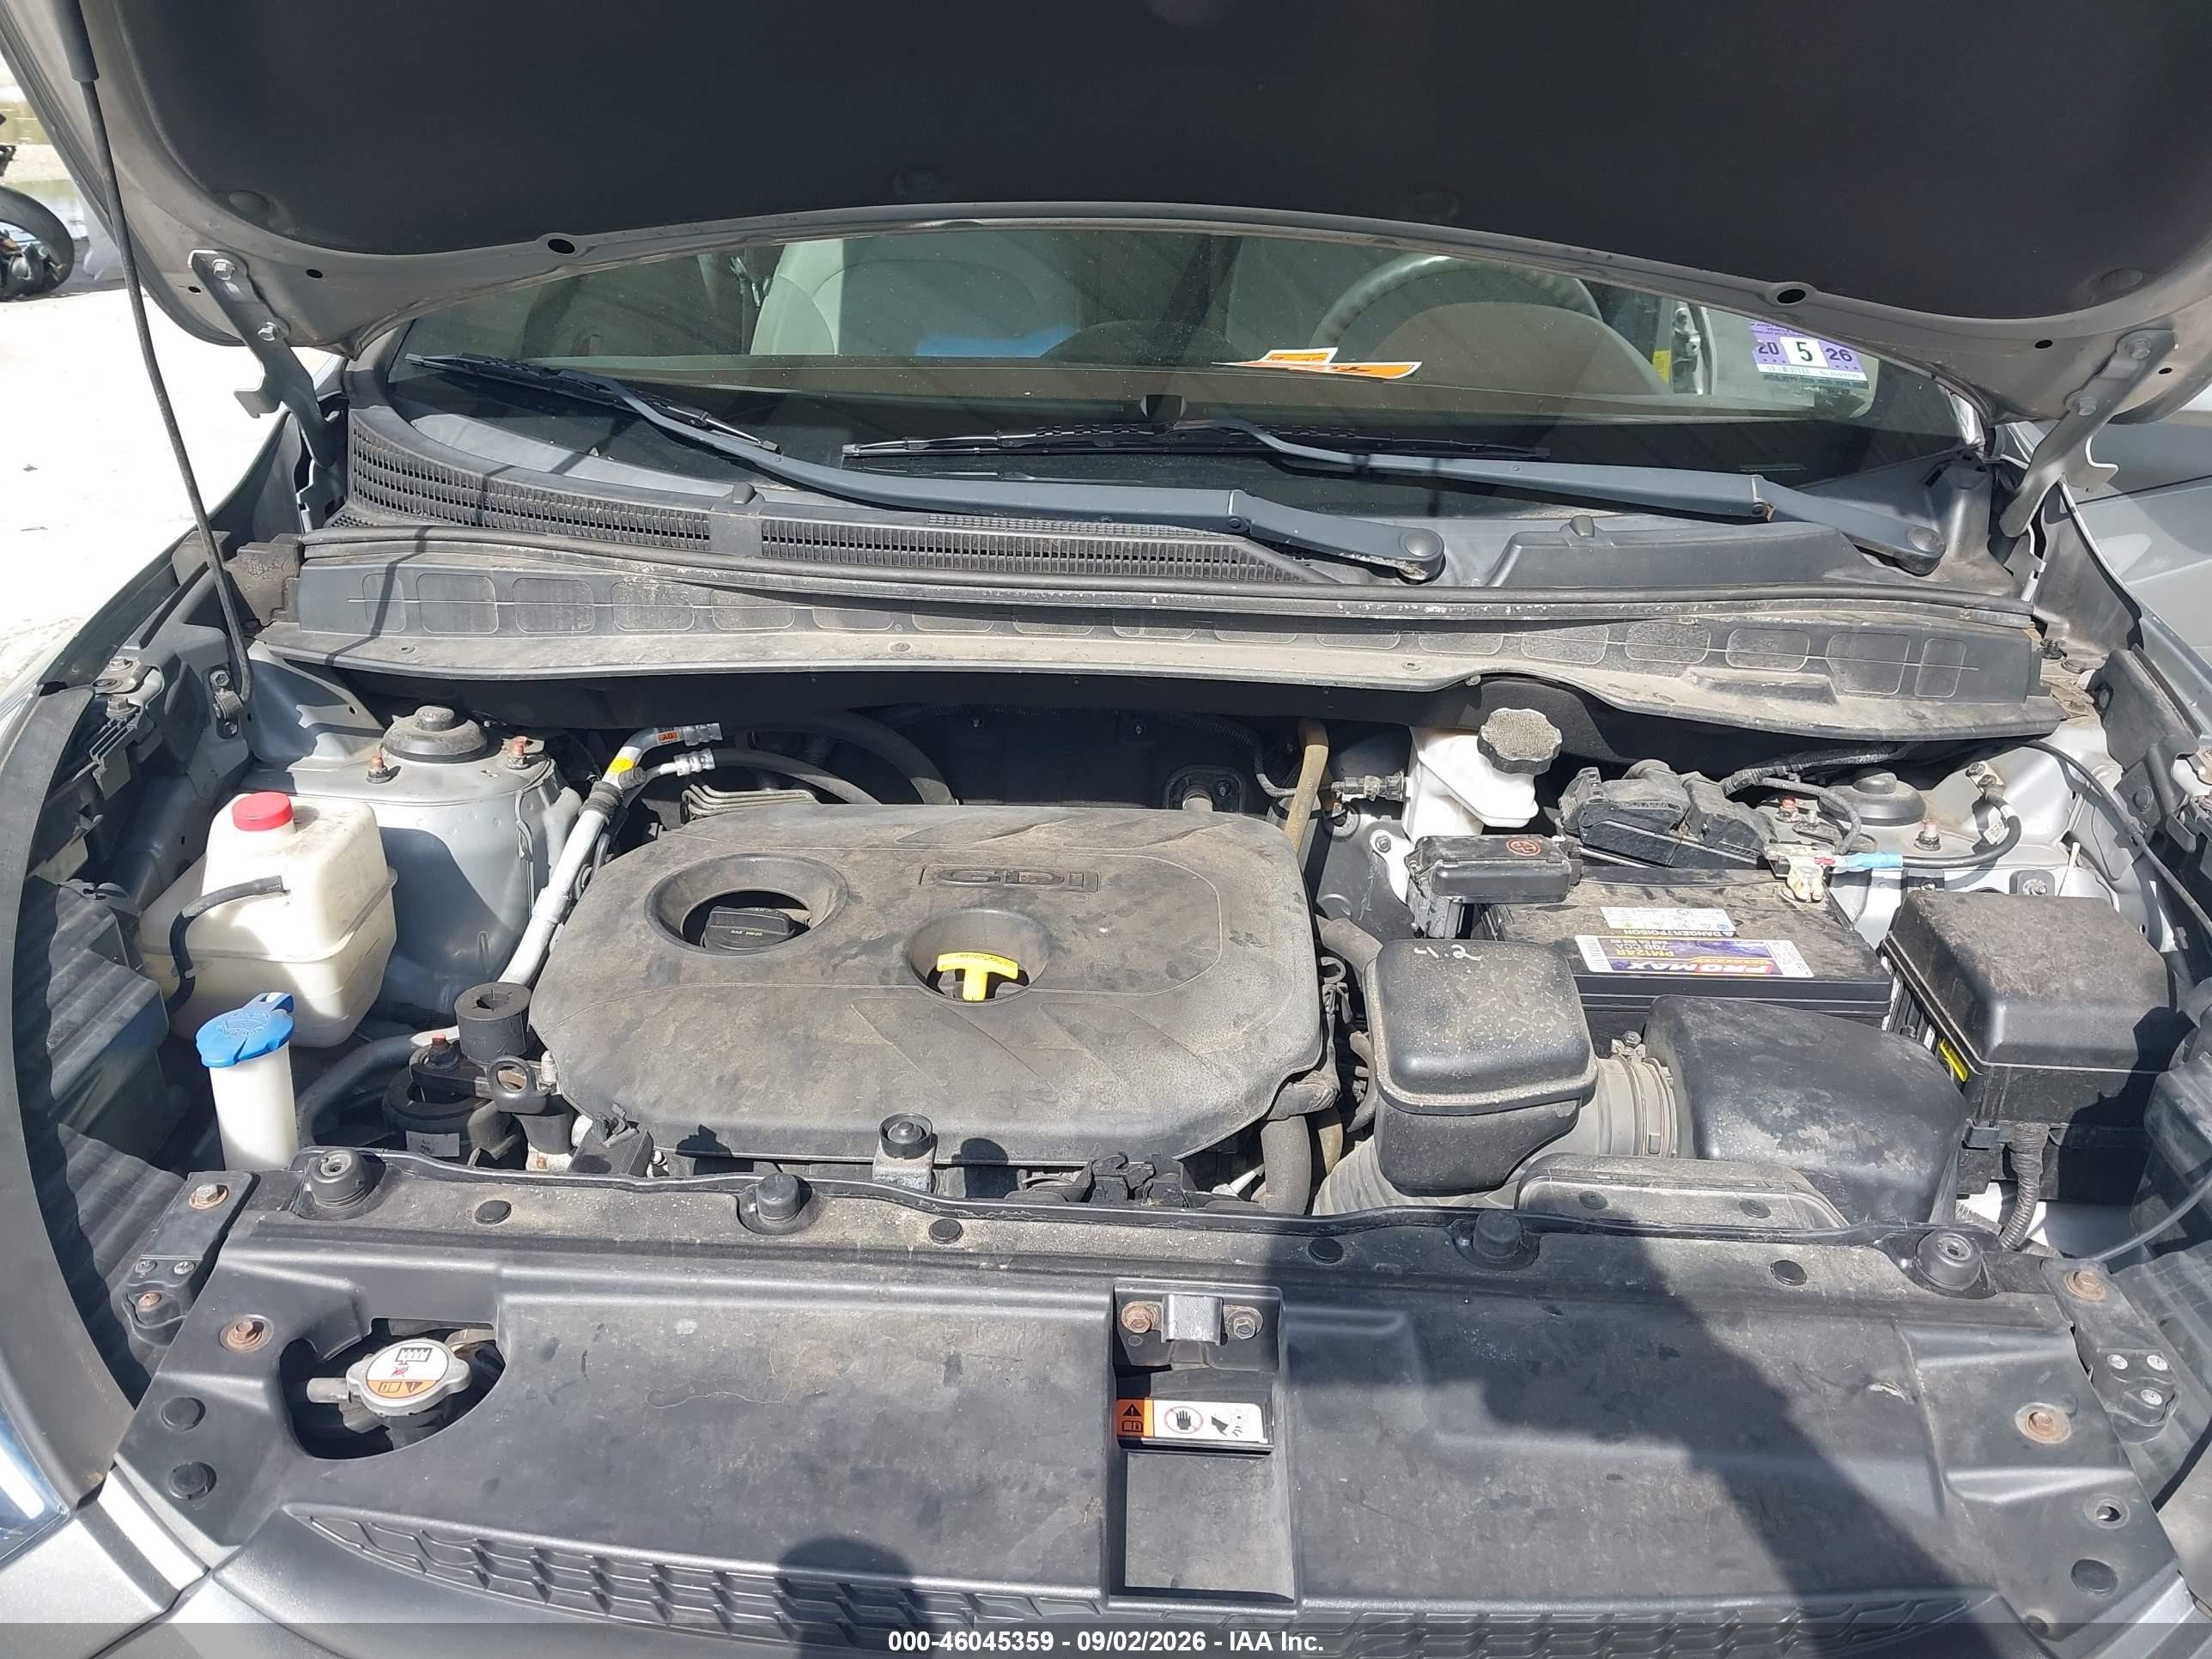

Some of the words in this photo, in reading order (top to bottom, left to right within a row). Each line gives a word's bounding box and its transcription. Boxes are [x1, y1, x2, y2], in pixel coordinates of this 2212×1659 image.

[1758, 342, 1780, 356] 20
[1796, 341, 1814, 362] 5
[1826, 347, 1853, 362] 26
[934, 868, 1085, 888] GDI
[1616, 949, 1674, 957] PM124R
